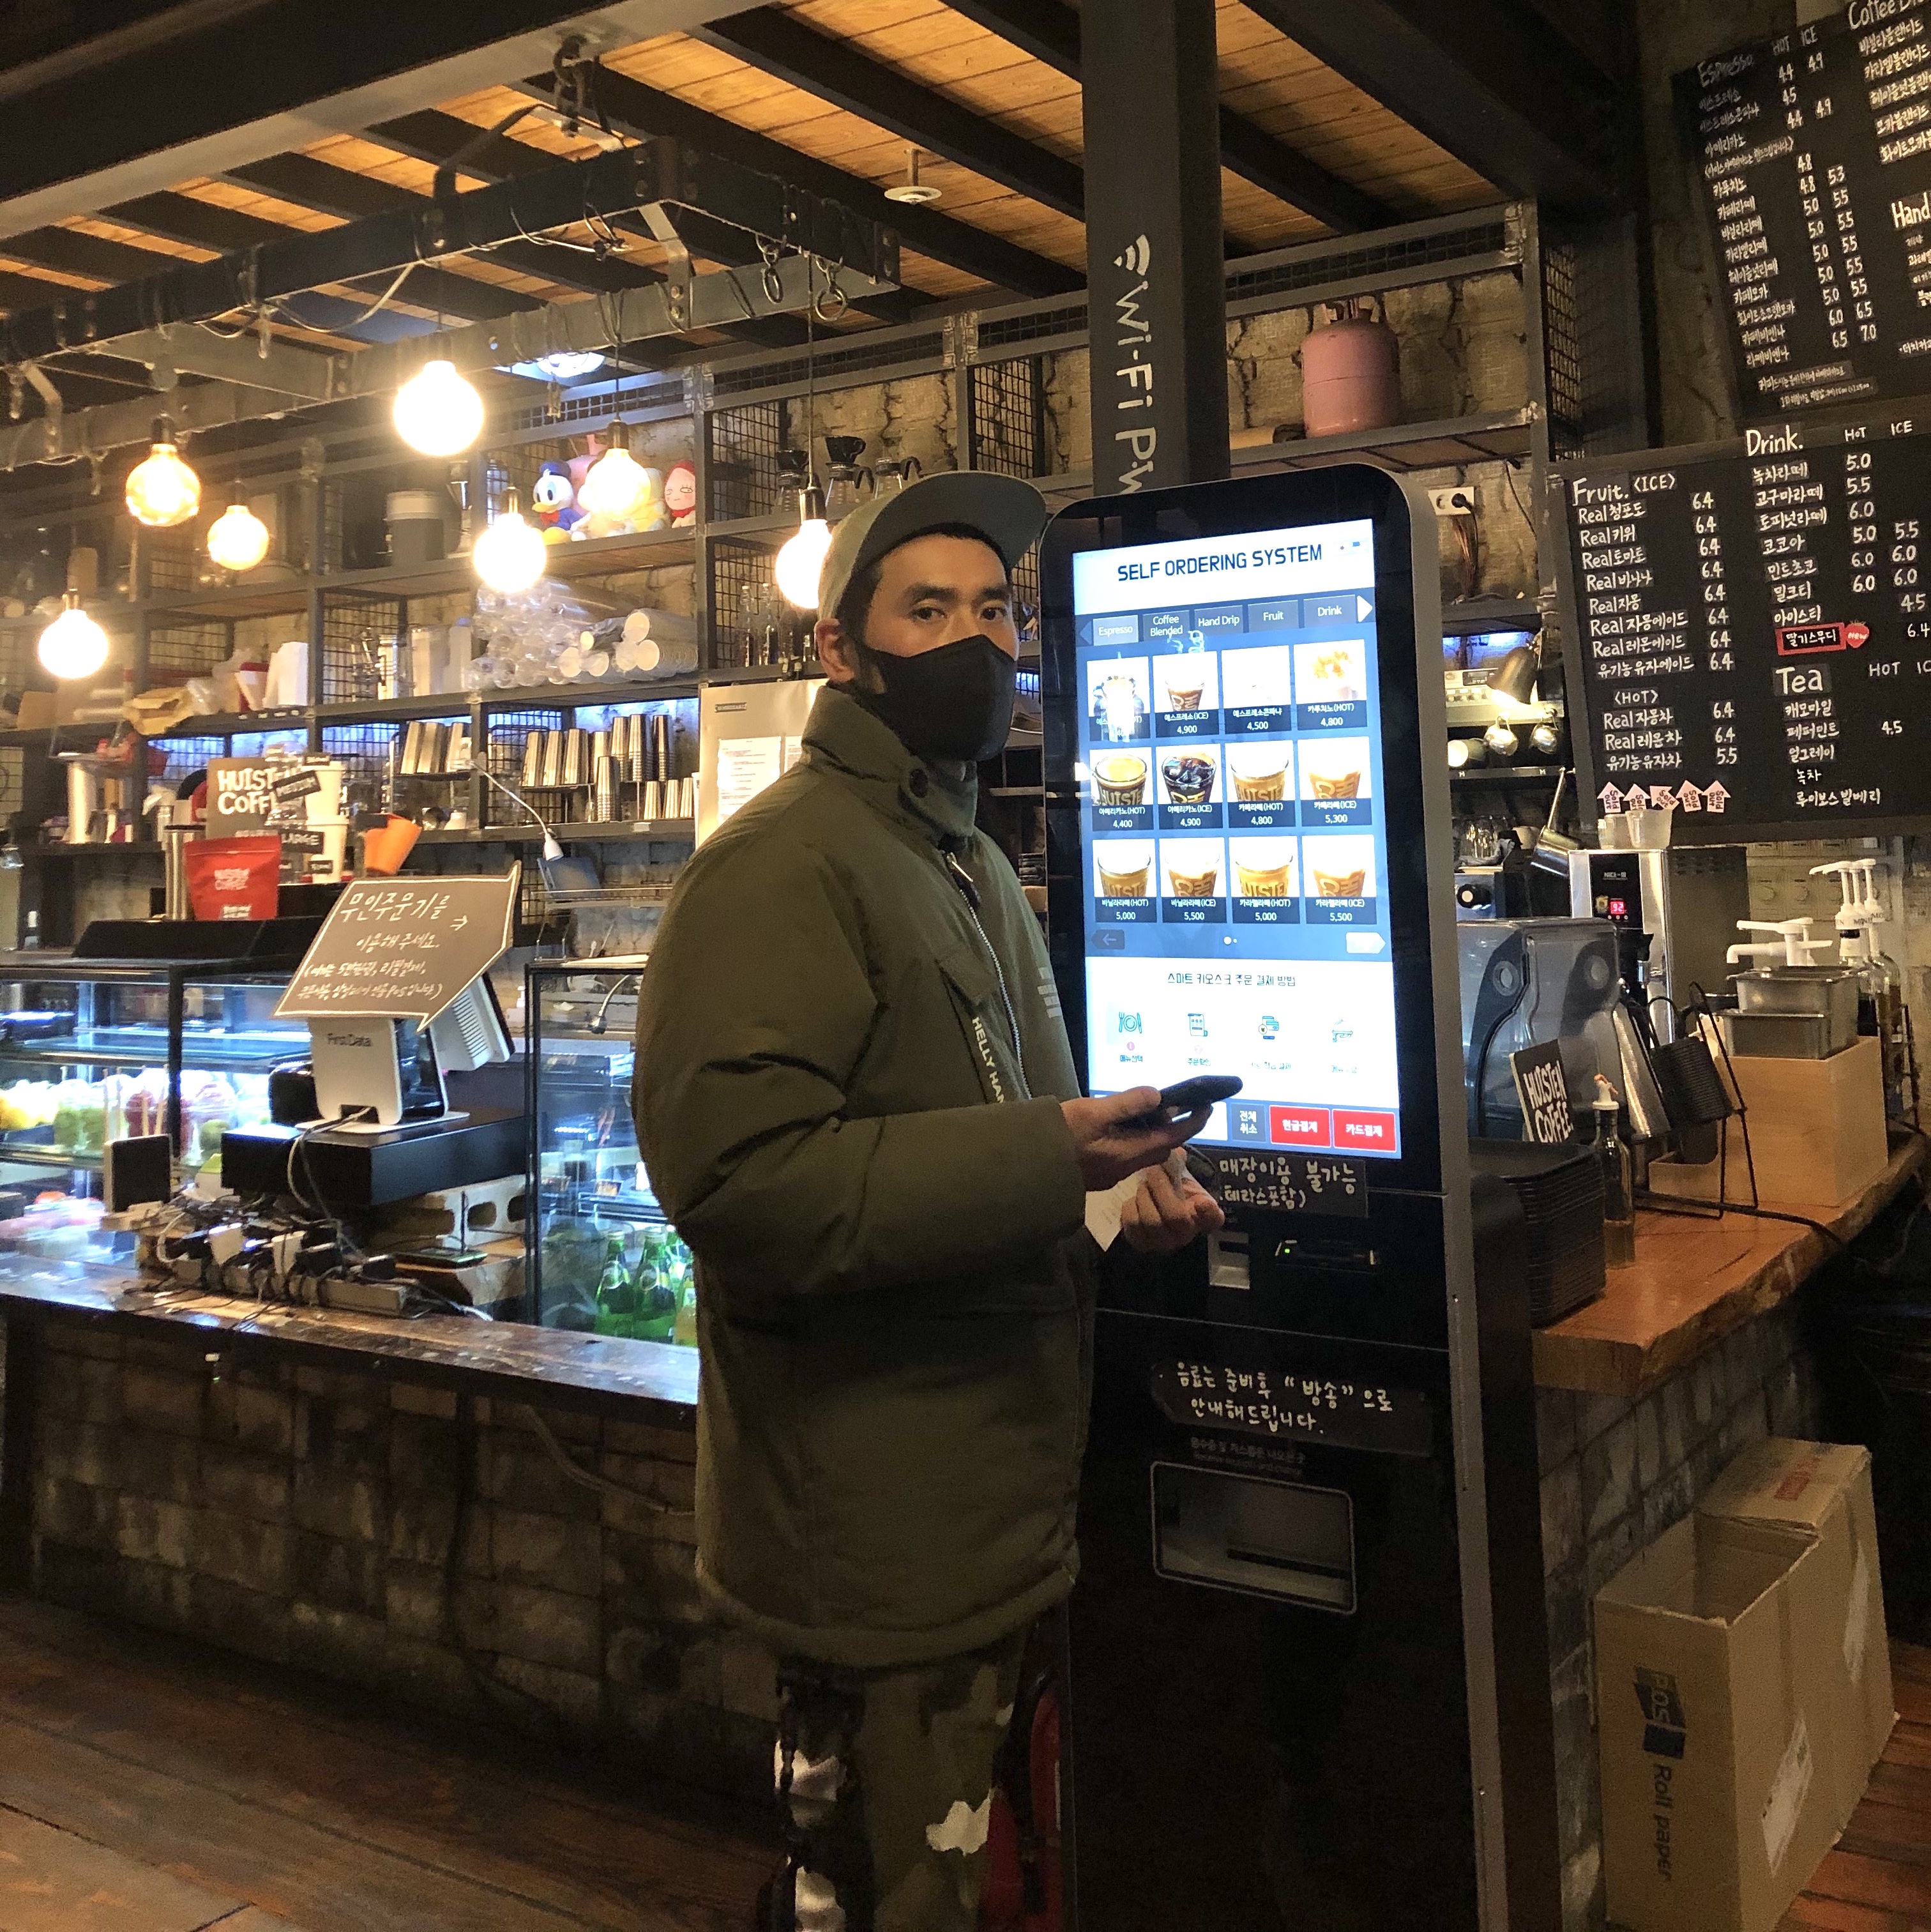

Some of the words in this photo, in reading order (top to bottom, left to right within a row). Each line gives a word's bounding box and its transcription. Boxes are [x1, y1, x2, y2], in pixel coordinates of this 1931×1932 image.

[1849, 0, 1896, 29] Coffee
[1891, 192, 1930, 227] Hand
[1891, 420, 1912, 436] ICE
[1753, 462, 1808, 485] 녹차라떼
[1846, 453, 1871, 470] 5.0
[1756, 484, 1822, 506] 고구마라떼
[1846, 476, 1870, 495] 5.5
[1693, 492, 1714, 509] 6.4
[1695, 515, 1716, 533] 6.4
[1759, 506, 1827, 531] 토피넛라떼
[1849, 501, 1874, 520] 6.0
[1762, 534, 1805, 554] 코코아
[1852, 526, 1877, 544] 5.0
[1895, 521, 1919, 540] 5.5
[1699, 538, 1720, 556] 6.4
[1117, 561, 1160, 582] SELF
[1165, 552, 1247, 576] ORDERING
[1252, 544, 1322, 568] SYSTEM
[1702, 561, 1723, 578] 6.4
[1768, 559, 1817, 581] 민트초코
[1852, 552, 1874, 567] 6.0
[1892, 545, 1916, 562] 6.0
[1704, 584, 1725, 602] 6.4
[1774, 581, 1811, 603] 밀크티
[1852, 575, 1875, 592] 6.0
[1894, 568, 1918, 586] 6.0
[1263, 611, 1284, 622] Fruit
[1317, 605, 1342, 617] Drink
[1708, 608, 1729, 625] 6.4
[1774, 605, 1821, 626] 아이스티
[1153, 615, 1179, 625] Coffee
[1198, 617, 1220, 627] Hand
[1222, 615, 1239, 627] Drip
[1098, 625, 1133, 636] Espresso
[1150, 625, 1183, 636] Blended
[1786, 629, 1836, 648] 딸기스무디
[1907, 623, 1930, 637] 6.4
[1710, 631, 1732, 648] 6.4
[1710, 653, 1734, 670] 6.4
[1775, 666, 1823, 695] Tea
[1869, 662, 1900, 676] HOT
[1713, 702, 1734, 719] 6.4
[1785, 699, 1832, 718] 캐모마일
[1177, 725, 1197, 734] 4,900
[1246, 721, 1268, 731] 4,500
[1321, 717, 1343, 727] 4,800
[1787, 722, 1839, 740] 페퍼민트
[1881, 720, 1903, 734] 4.5
[1715, 727, 1735, 743] 6.4
[1716, 747, 1738, 764] 5.5
[1789, 744, 1835, 763] 얼그레이
[1796, 769, 1822, 784] 녹차
[1113, 819, 1132, 828] 4,400
[1180, 818, 1201, 827] 4,900
[1251, 816, 1273, 825] 4,800
[1325, 814, 1348, 824] 5,300
[340, 892, 450, 922] 무인주문기를
[1116, 912, 1136, 920] 5,000
[1184, 912, 1204, 920] 5,500
[1255, 912, 1276, 921] 5,000
[1329, 912, 1352, 921] 5,500
[1167, 973, 1193, 984] 스마트
[1197, 973, 1232, 985] 키오스크
[1235, 974, 1253, 986] 주문
[1257, 975, 1274, 986] 결제
[1277, 975, 1296, 987] 방법
[972, 1017, 995, 1067] HELLY
[1523, 1060, 1568, 1109] HUISTEN
[1239, 1111, 1257, 1122] 전체
[1239, 1123, 1258, 1135] 취소
[1282, 1119, 1317, 1133] 현금결제
[1345, 1123, 1382, 1137] 카드결제
[1219, 1157, 1291, 1185] 매장이용
[1306, 1161, 1356, 1194] 불가능
[1177, 1361, 1216, 1388] 음료는
[1654, 1764, 1673, 1809] Roll
